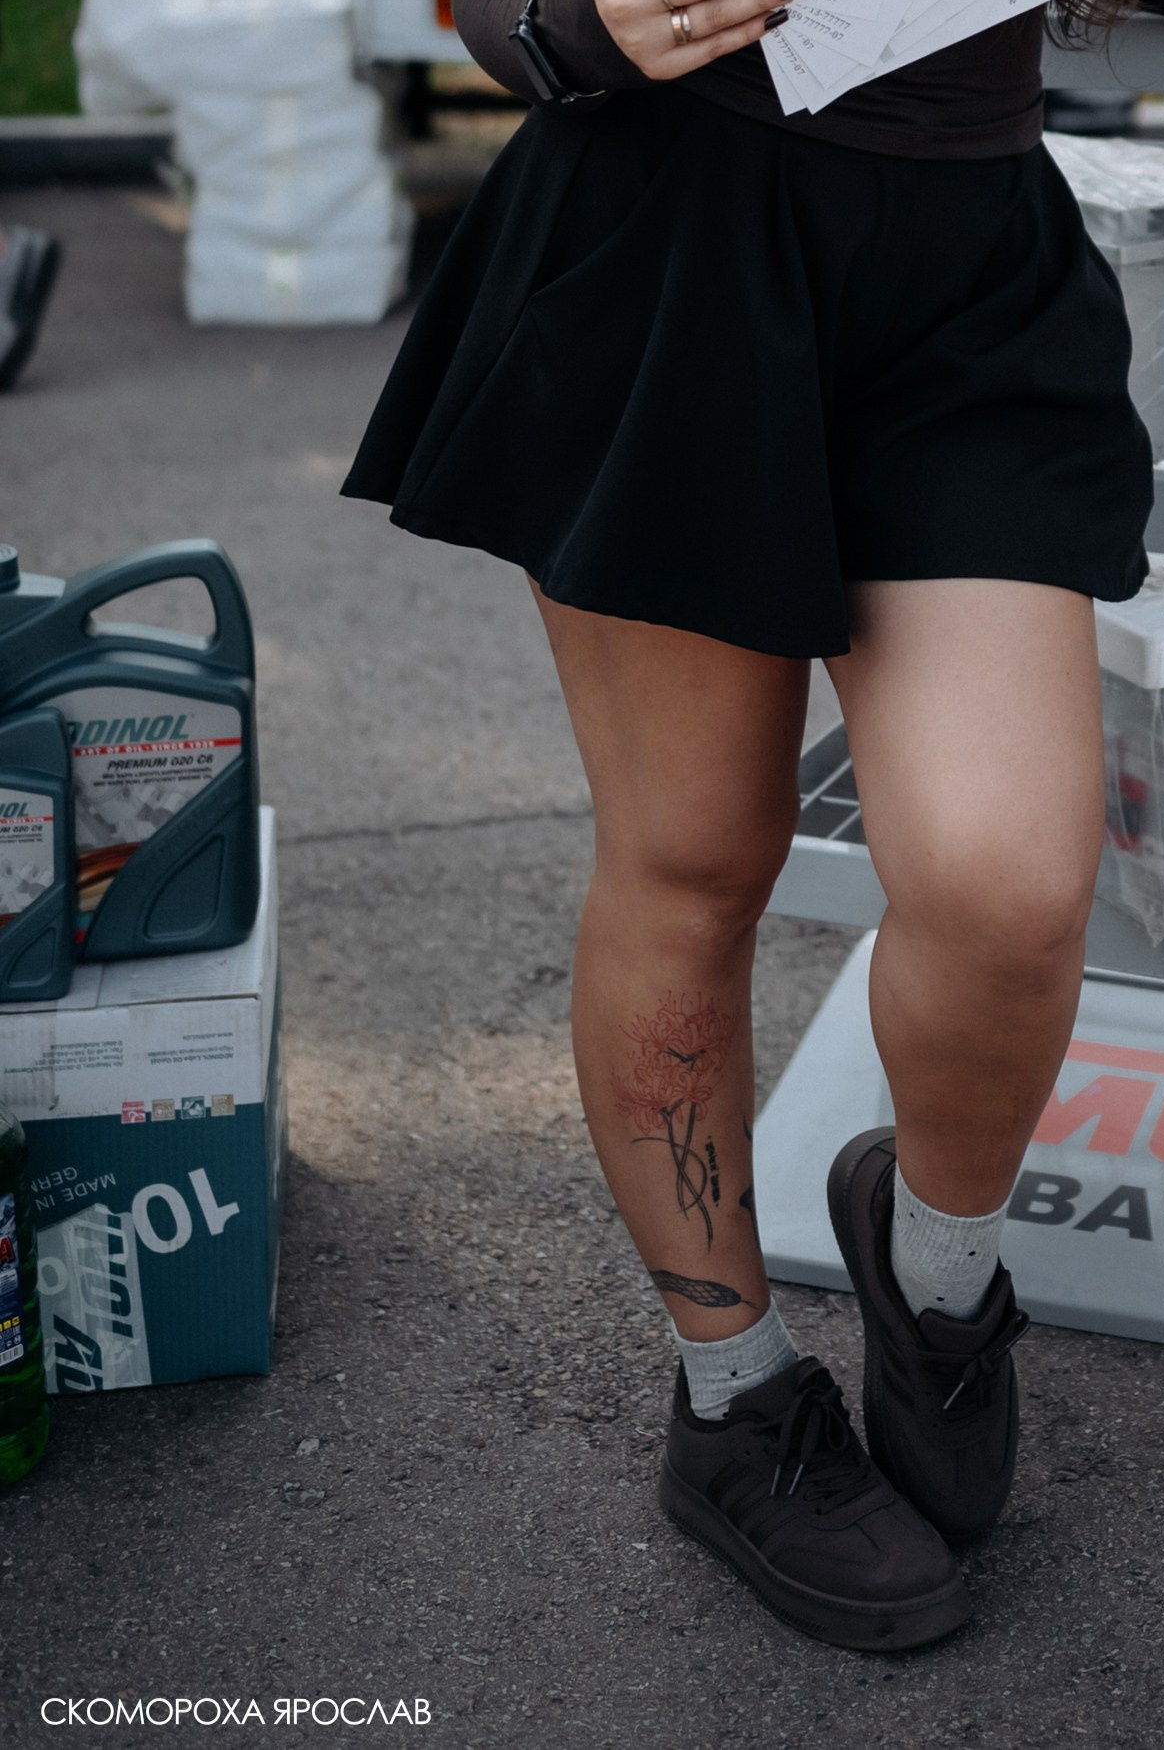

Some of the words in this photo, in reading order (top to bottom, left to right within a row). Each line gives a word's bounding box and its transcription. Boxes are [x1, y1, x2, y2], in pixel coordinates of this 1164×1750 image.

[69, 714, 189, 746] DINOL
[107, 758, 167, 771] PREMIUM
[63, 1172, 117, 1202] MADE
[36, 1192, 56, 1211] IN
